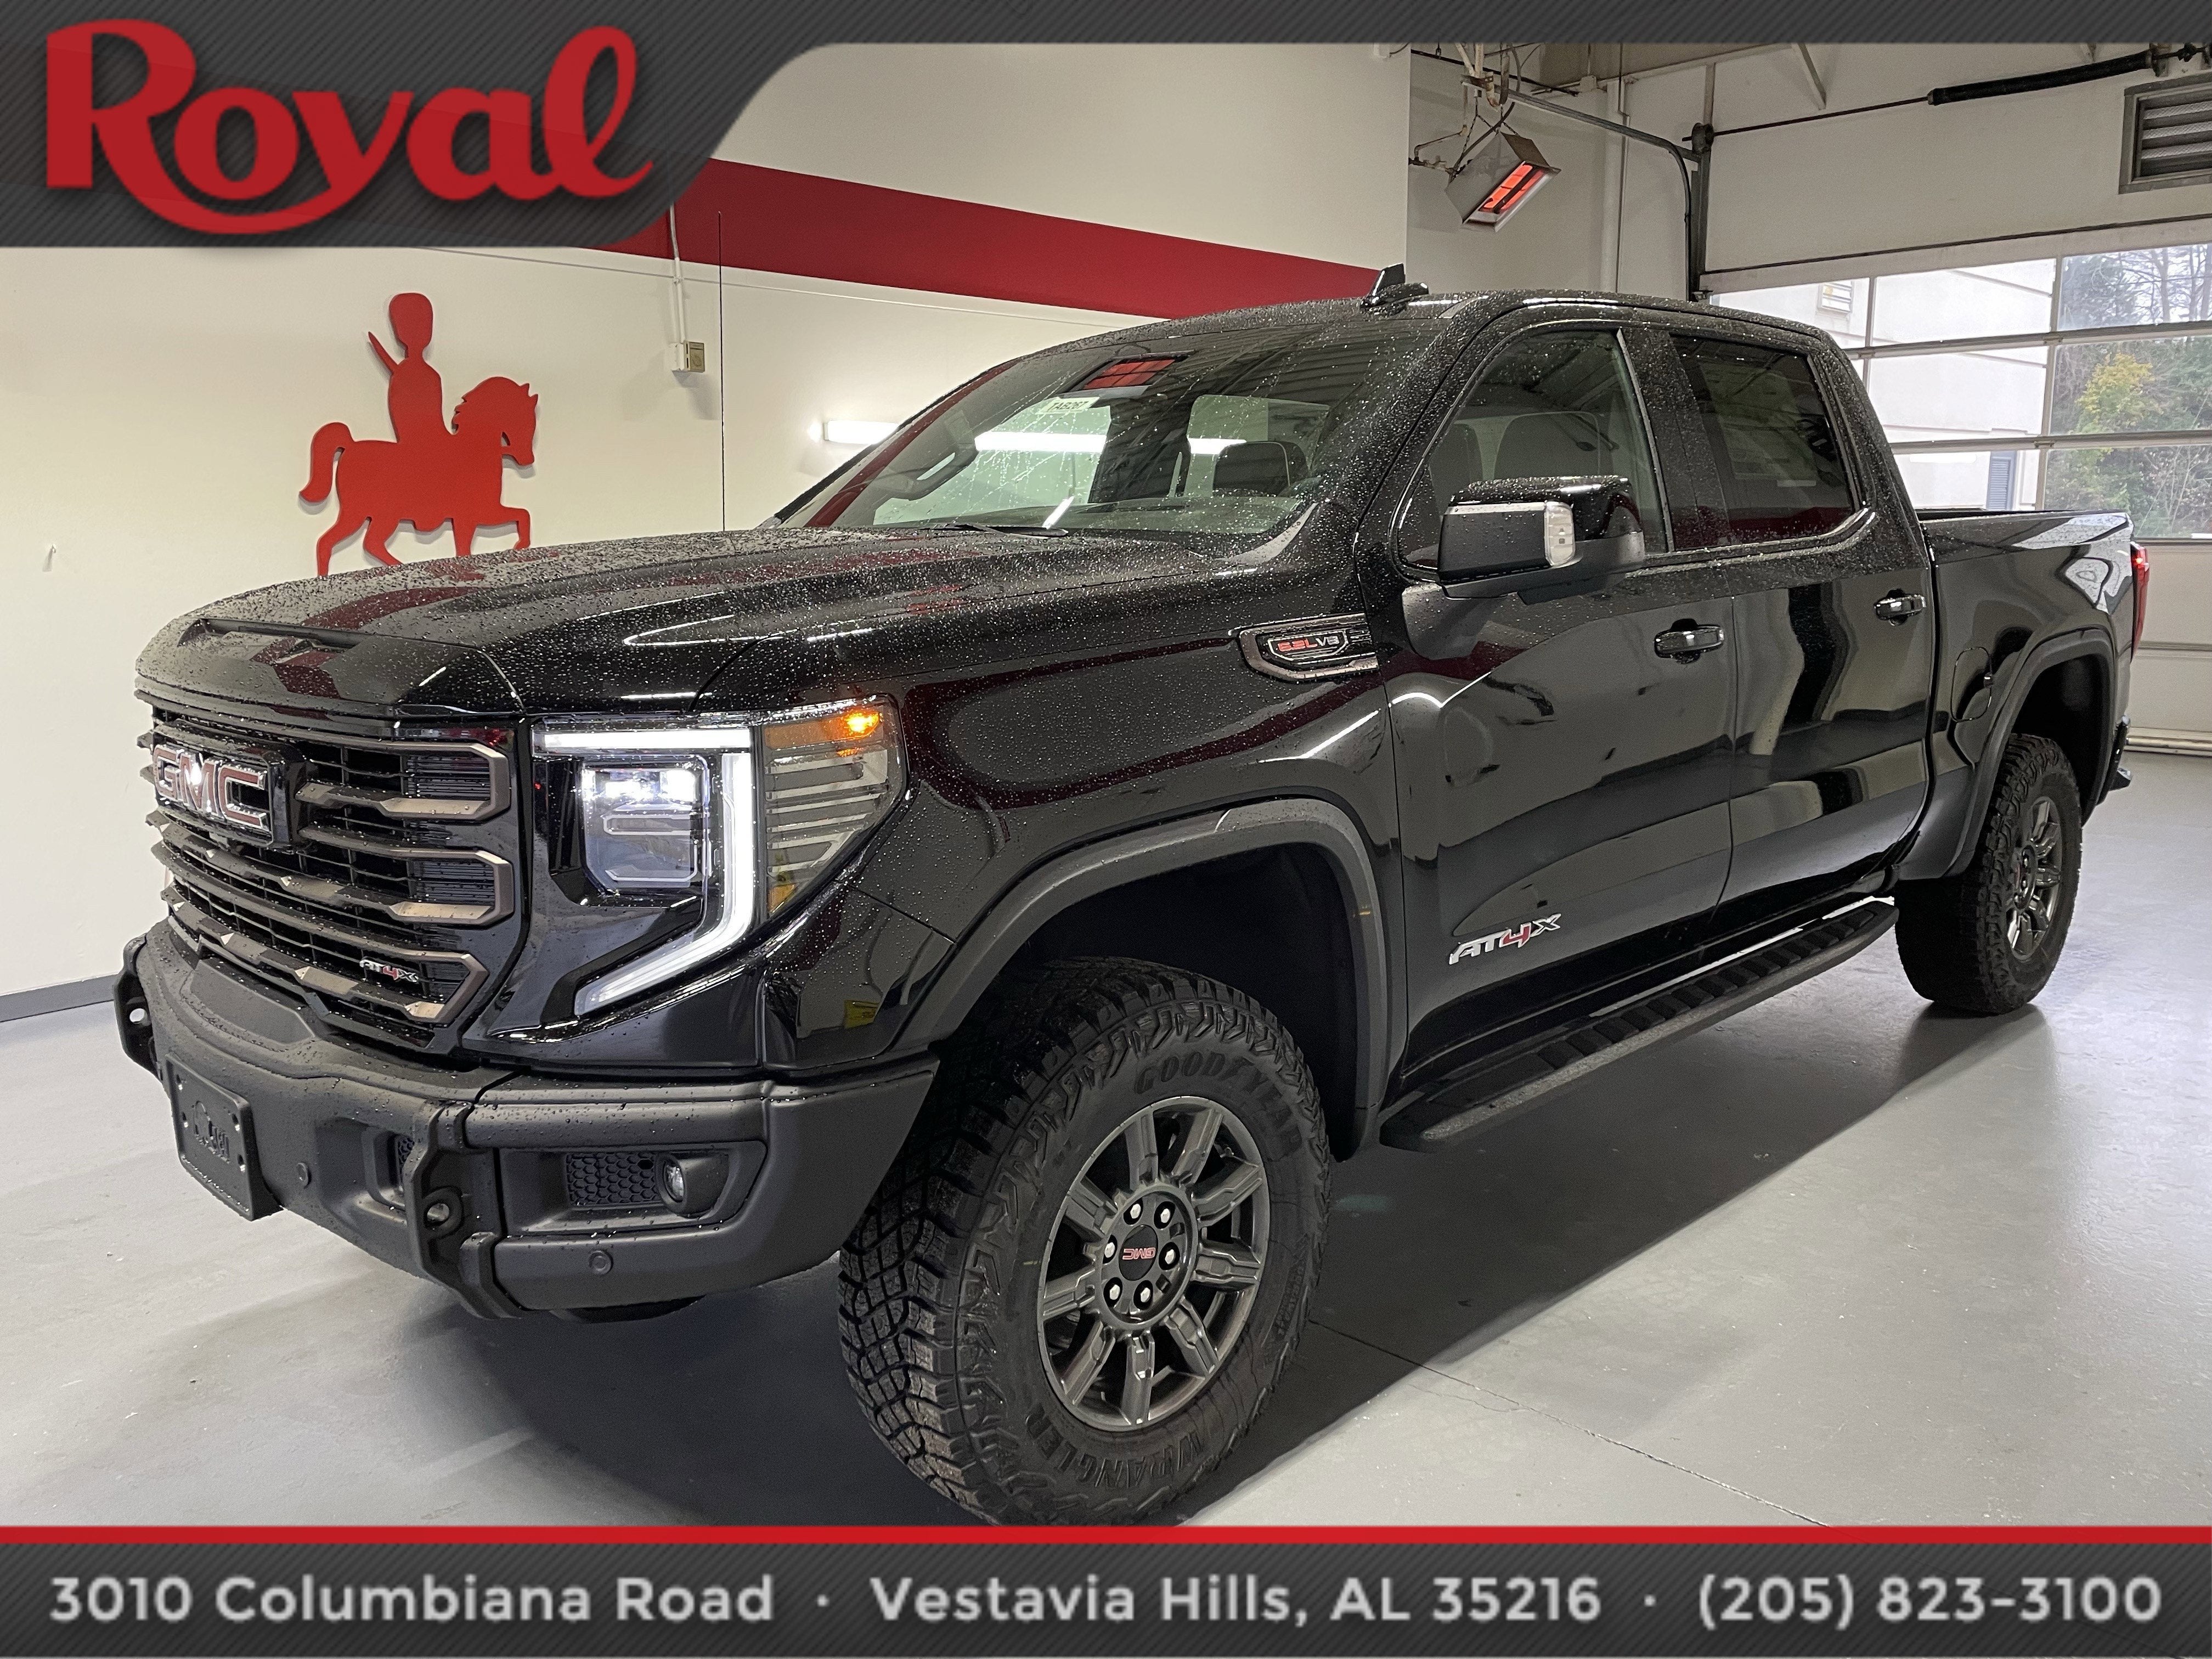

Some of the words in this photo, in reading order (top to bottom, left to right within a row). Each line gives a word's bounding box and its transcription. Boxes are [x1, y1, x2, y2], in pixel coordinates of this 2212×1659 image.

[153, 744, 267, 831] GMC
[359, 959, 419, 983] AT4X
[1449, 913, 1561, 965] AT4X
[1134, 1051, 1302, 1161] GOODYEAR
[1122, 1247, 1156, 1260] GMC
[1025, 1402, 1204, 1488] WRANGLER
